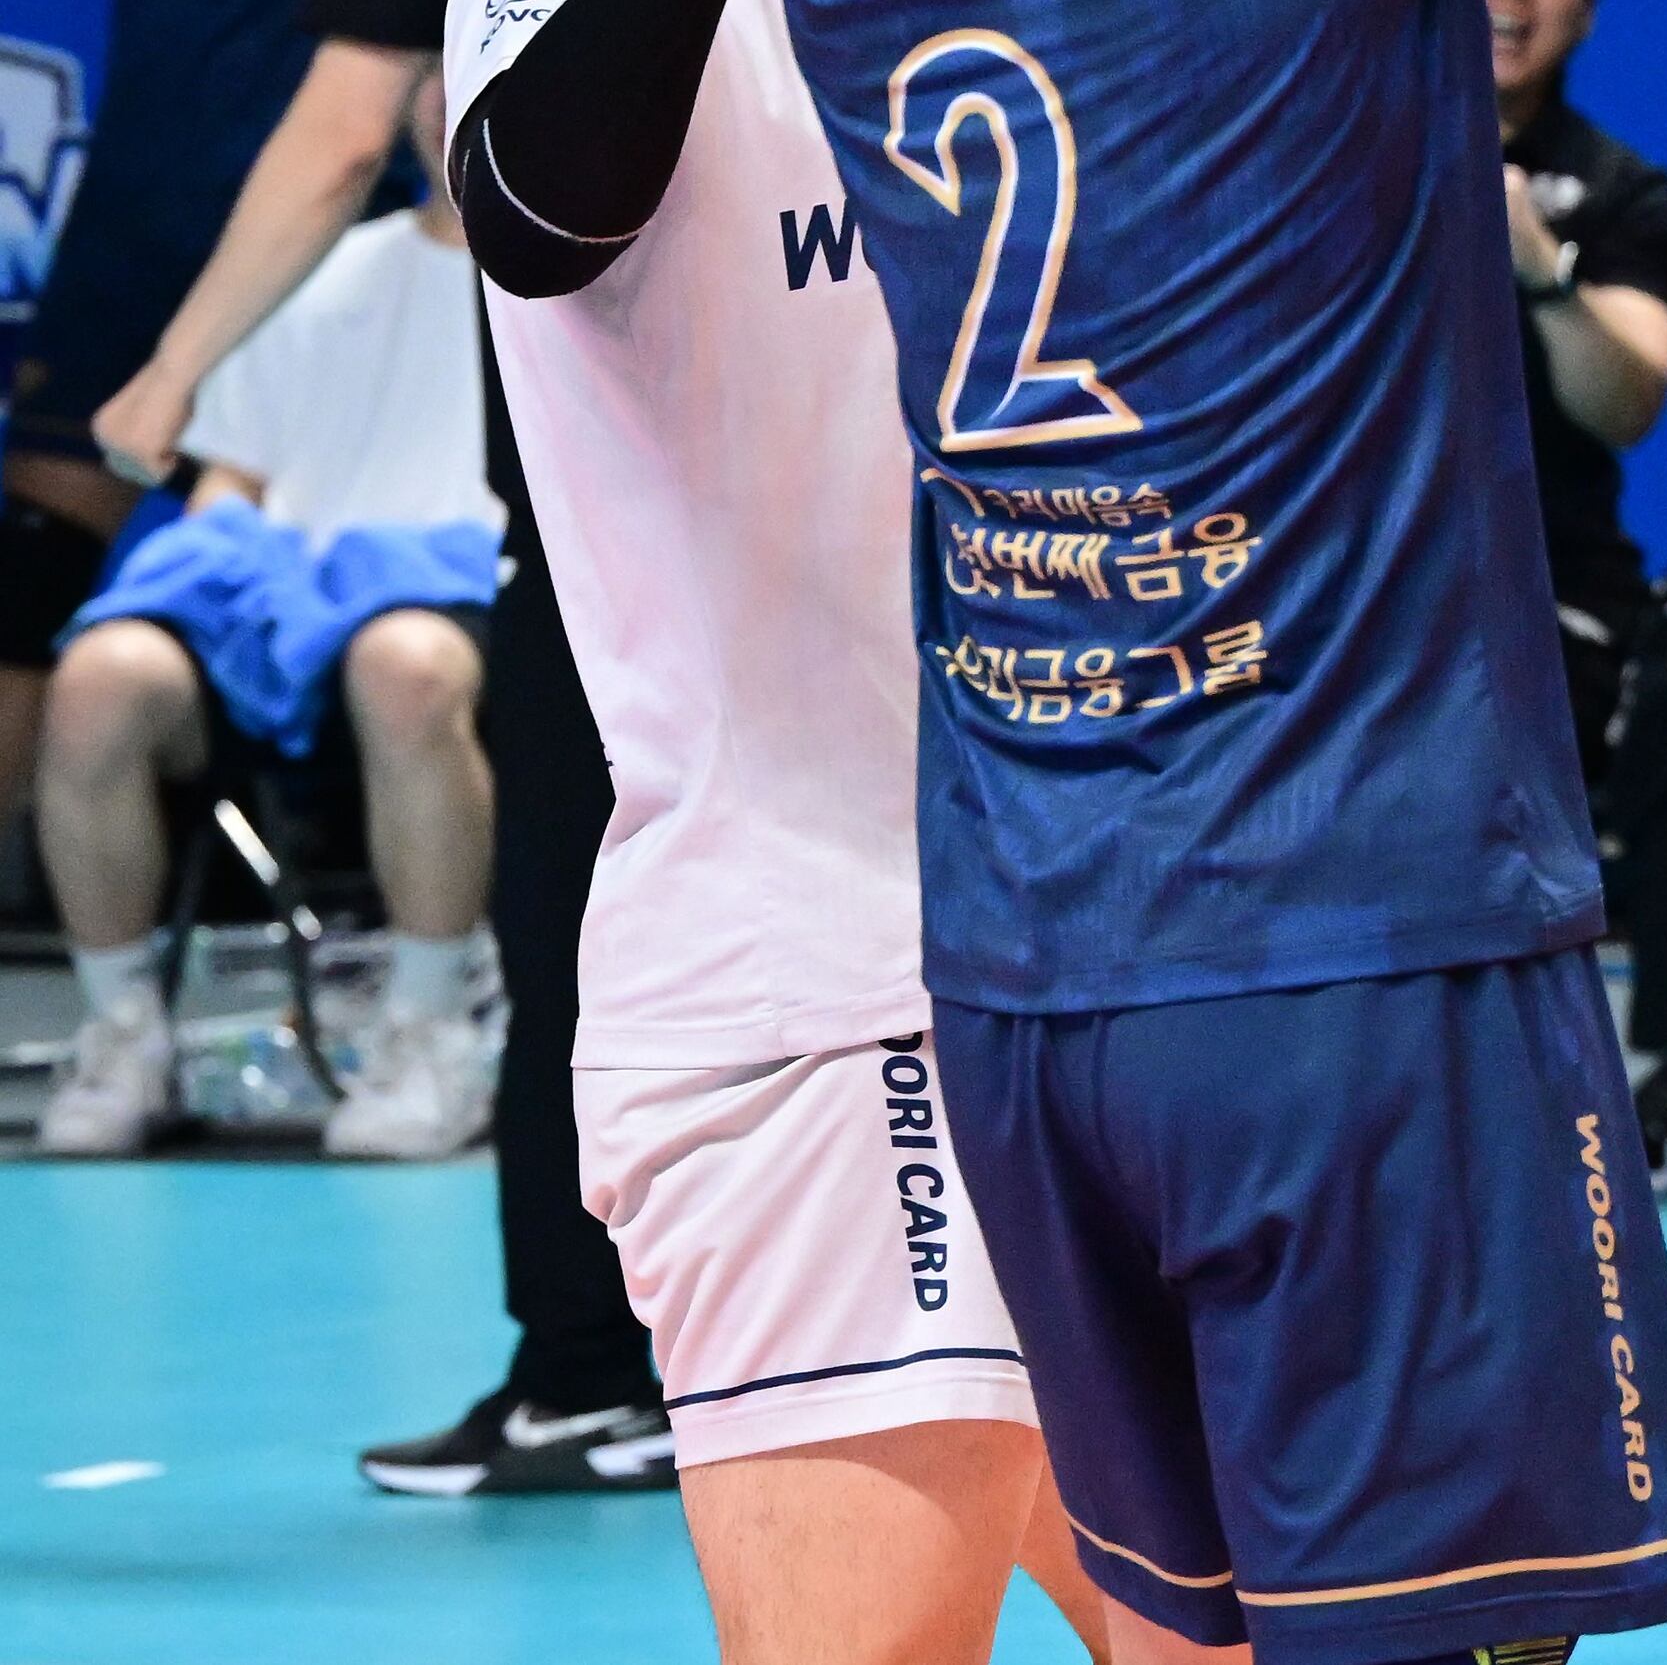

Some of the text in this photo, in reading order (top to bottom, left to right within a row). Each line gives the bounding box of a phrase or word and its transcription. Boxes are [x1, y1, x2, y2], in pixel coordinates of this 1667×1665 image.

[883, 27, 1144, 454] 2
[1114, 512, 1264, 602] 금융
[896, 1163, 948, 1314] CARD
[1575, 1111, 1655, 1503] WOORI CARD
